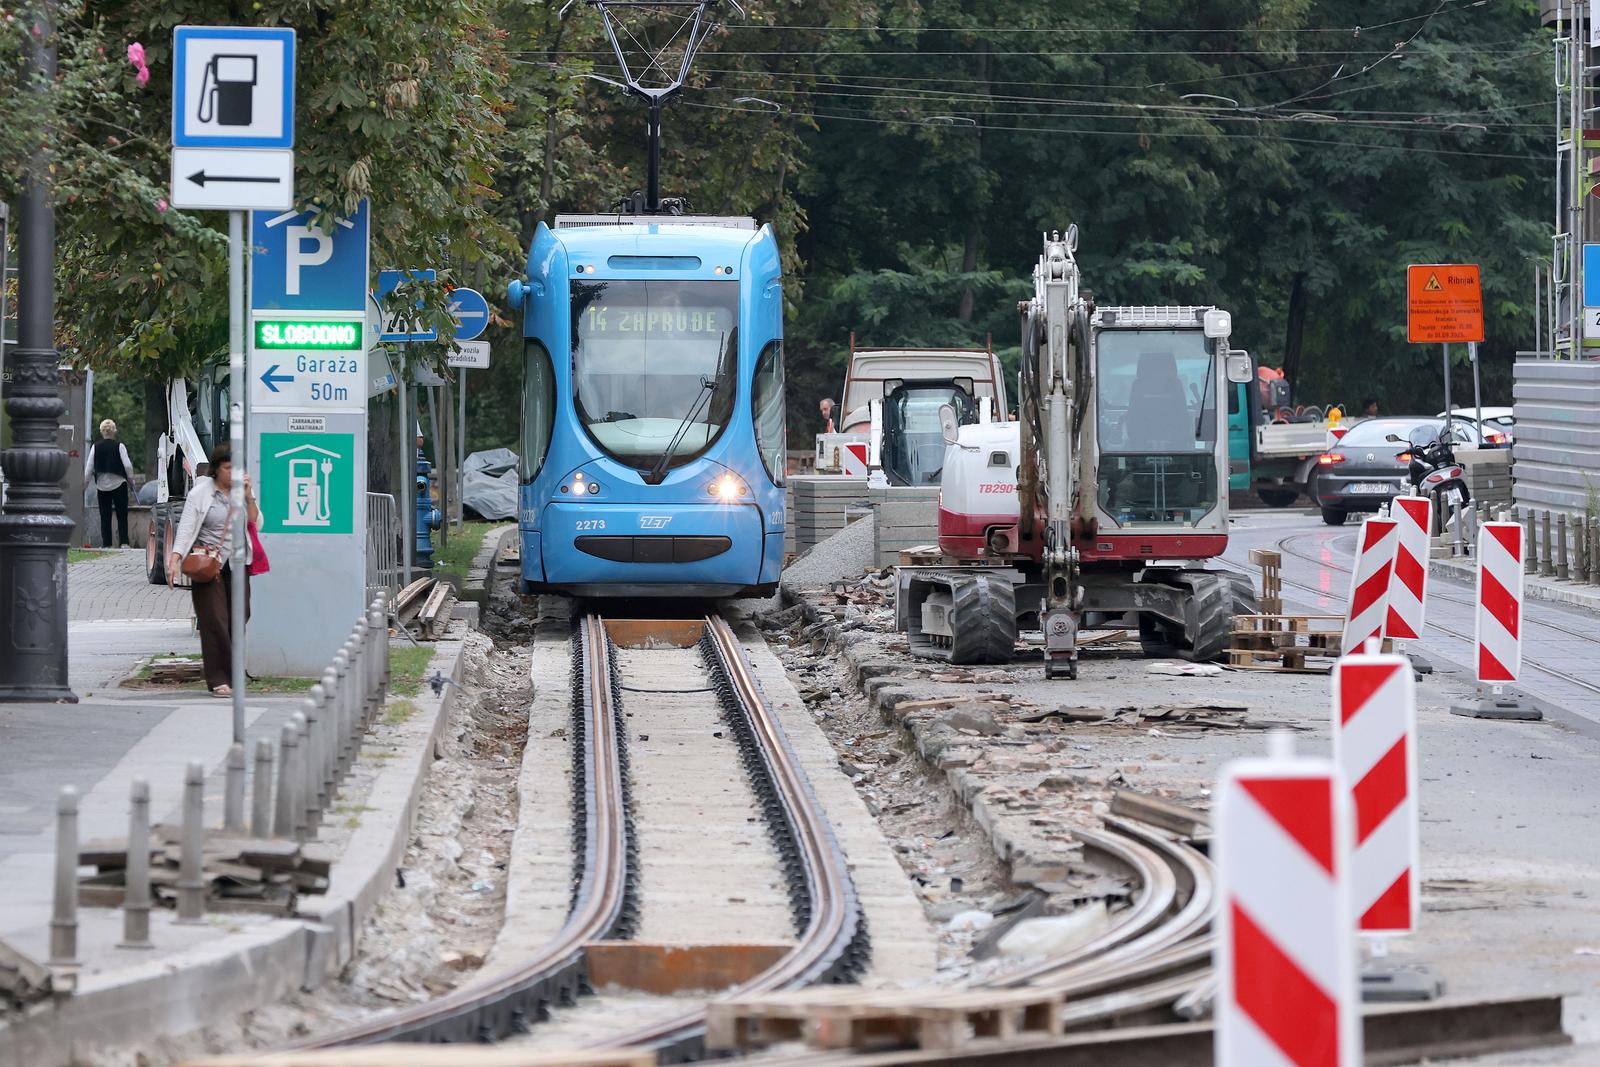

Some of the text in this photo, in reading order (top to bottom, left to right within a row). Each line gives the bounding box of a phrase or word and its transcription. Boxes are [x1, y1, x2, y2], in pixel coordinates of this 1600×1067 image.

[286, 225, 333, 295] P
[1447, 276, 1474, 286] Ribnjak
[588, 306, 608, 331] 14
[262, 324, 355, 345] SLOBODNO
[297, 354, 358, 373] Garaža
[311, 383, 348, 401] 50m
[575, 519, 606, 531] 2273
[640, 515, 673, 529] ZET
